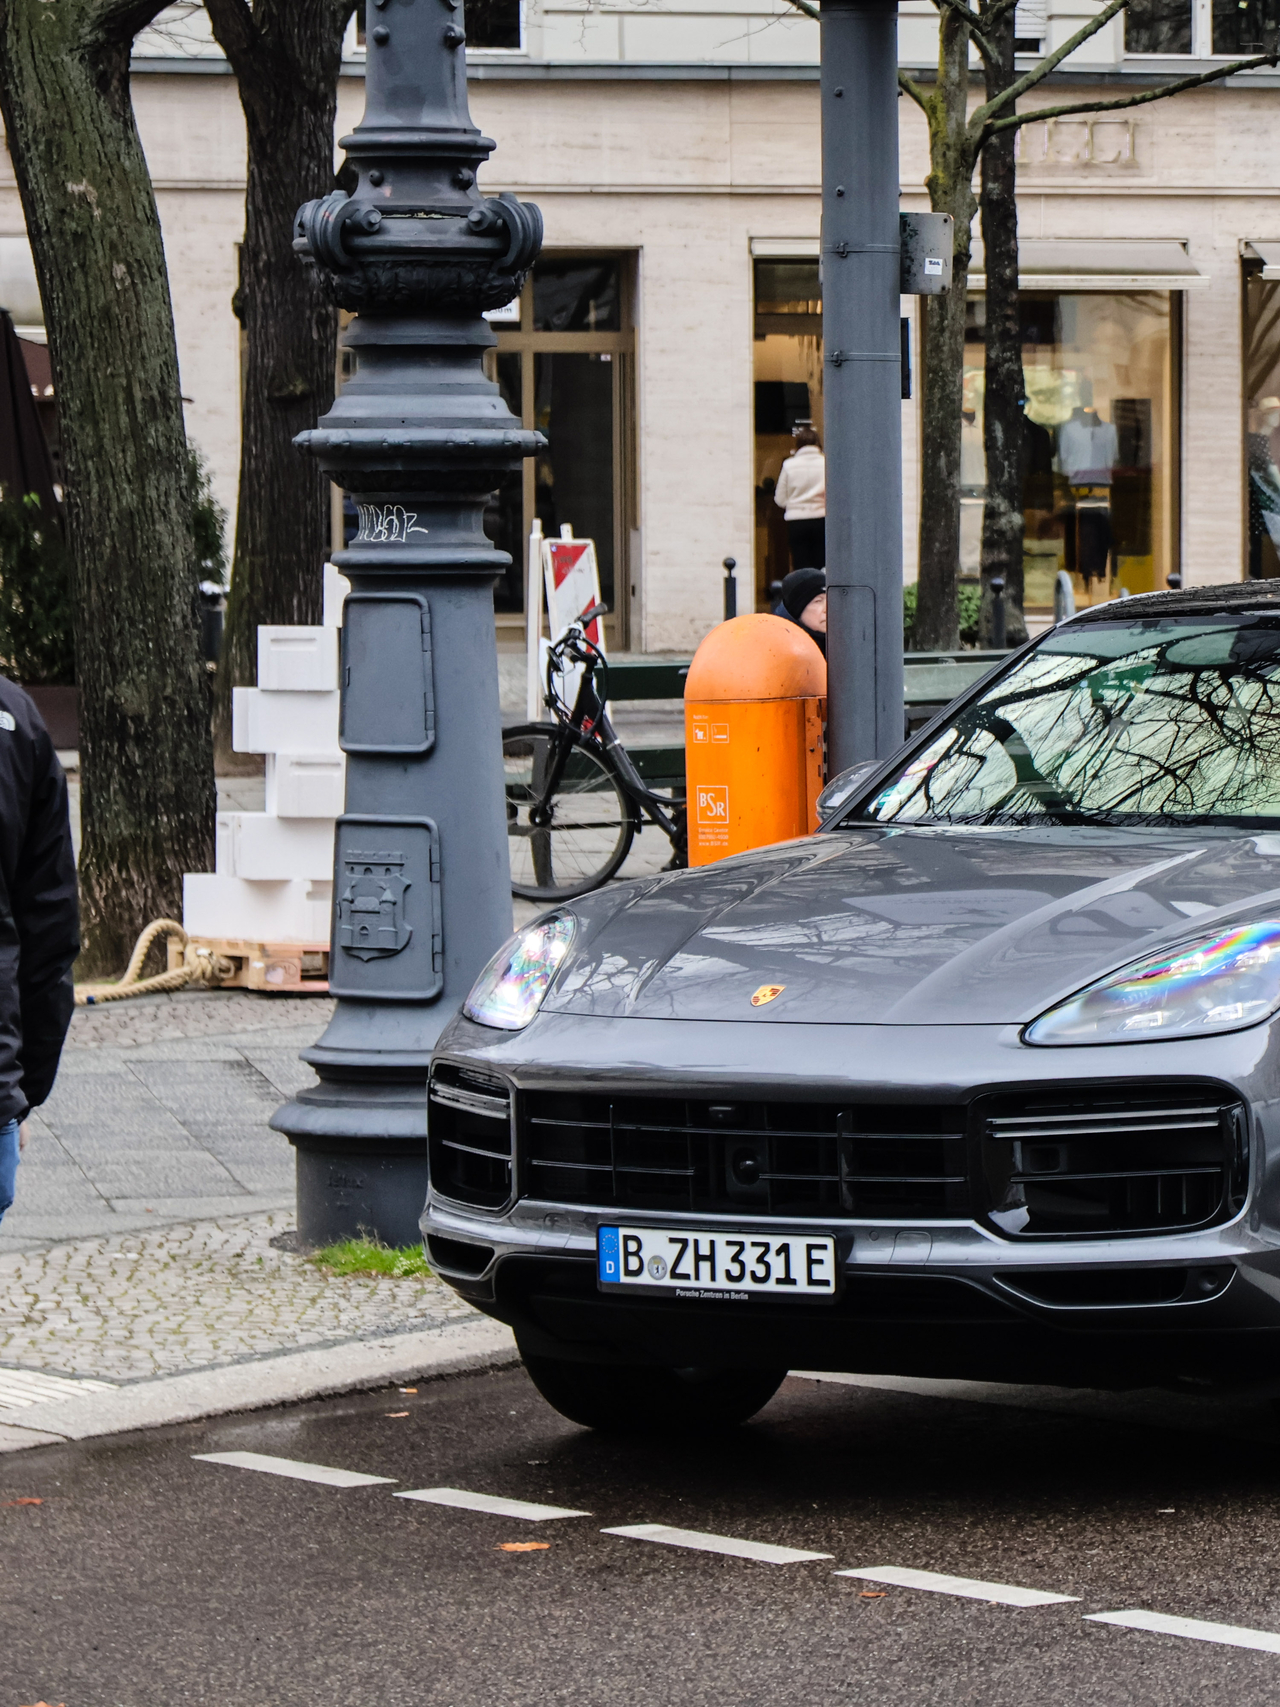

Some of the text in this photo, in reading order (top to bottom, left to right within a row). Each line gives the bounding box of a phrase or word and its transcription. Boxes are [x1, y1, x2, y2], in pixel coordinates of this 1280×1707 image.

[699, 792, 726, 817] BSR
[605, 1260, 615, 1274] D
[621, 1234, 645, 1277] B
[675, 1288, 700, 1298] Porsche
[730, 1292, 749, 1300] Berlin
